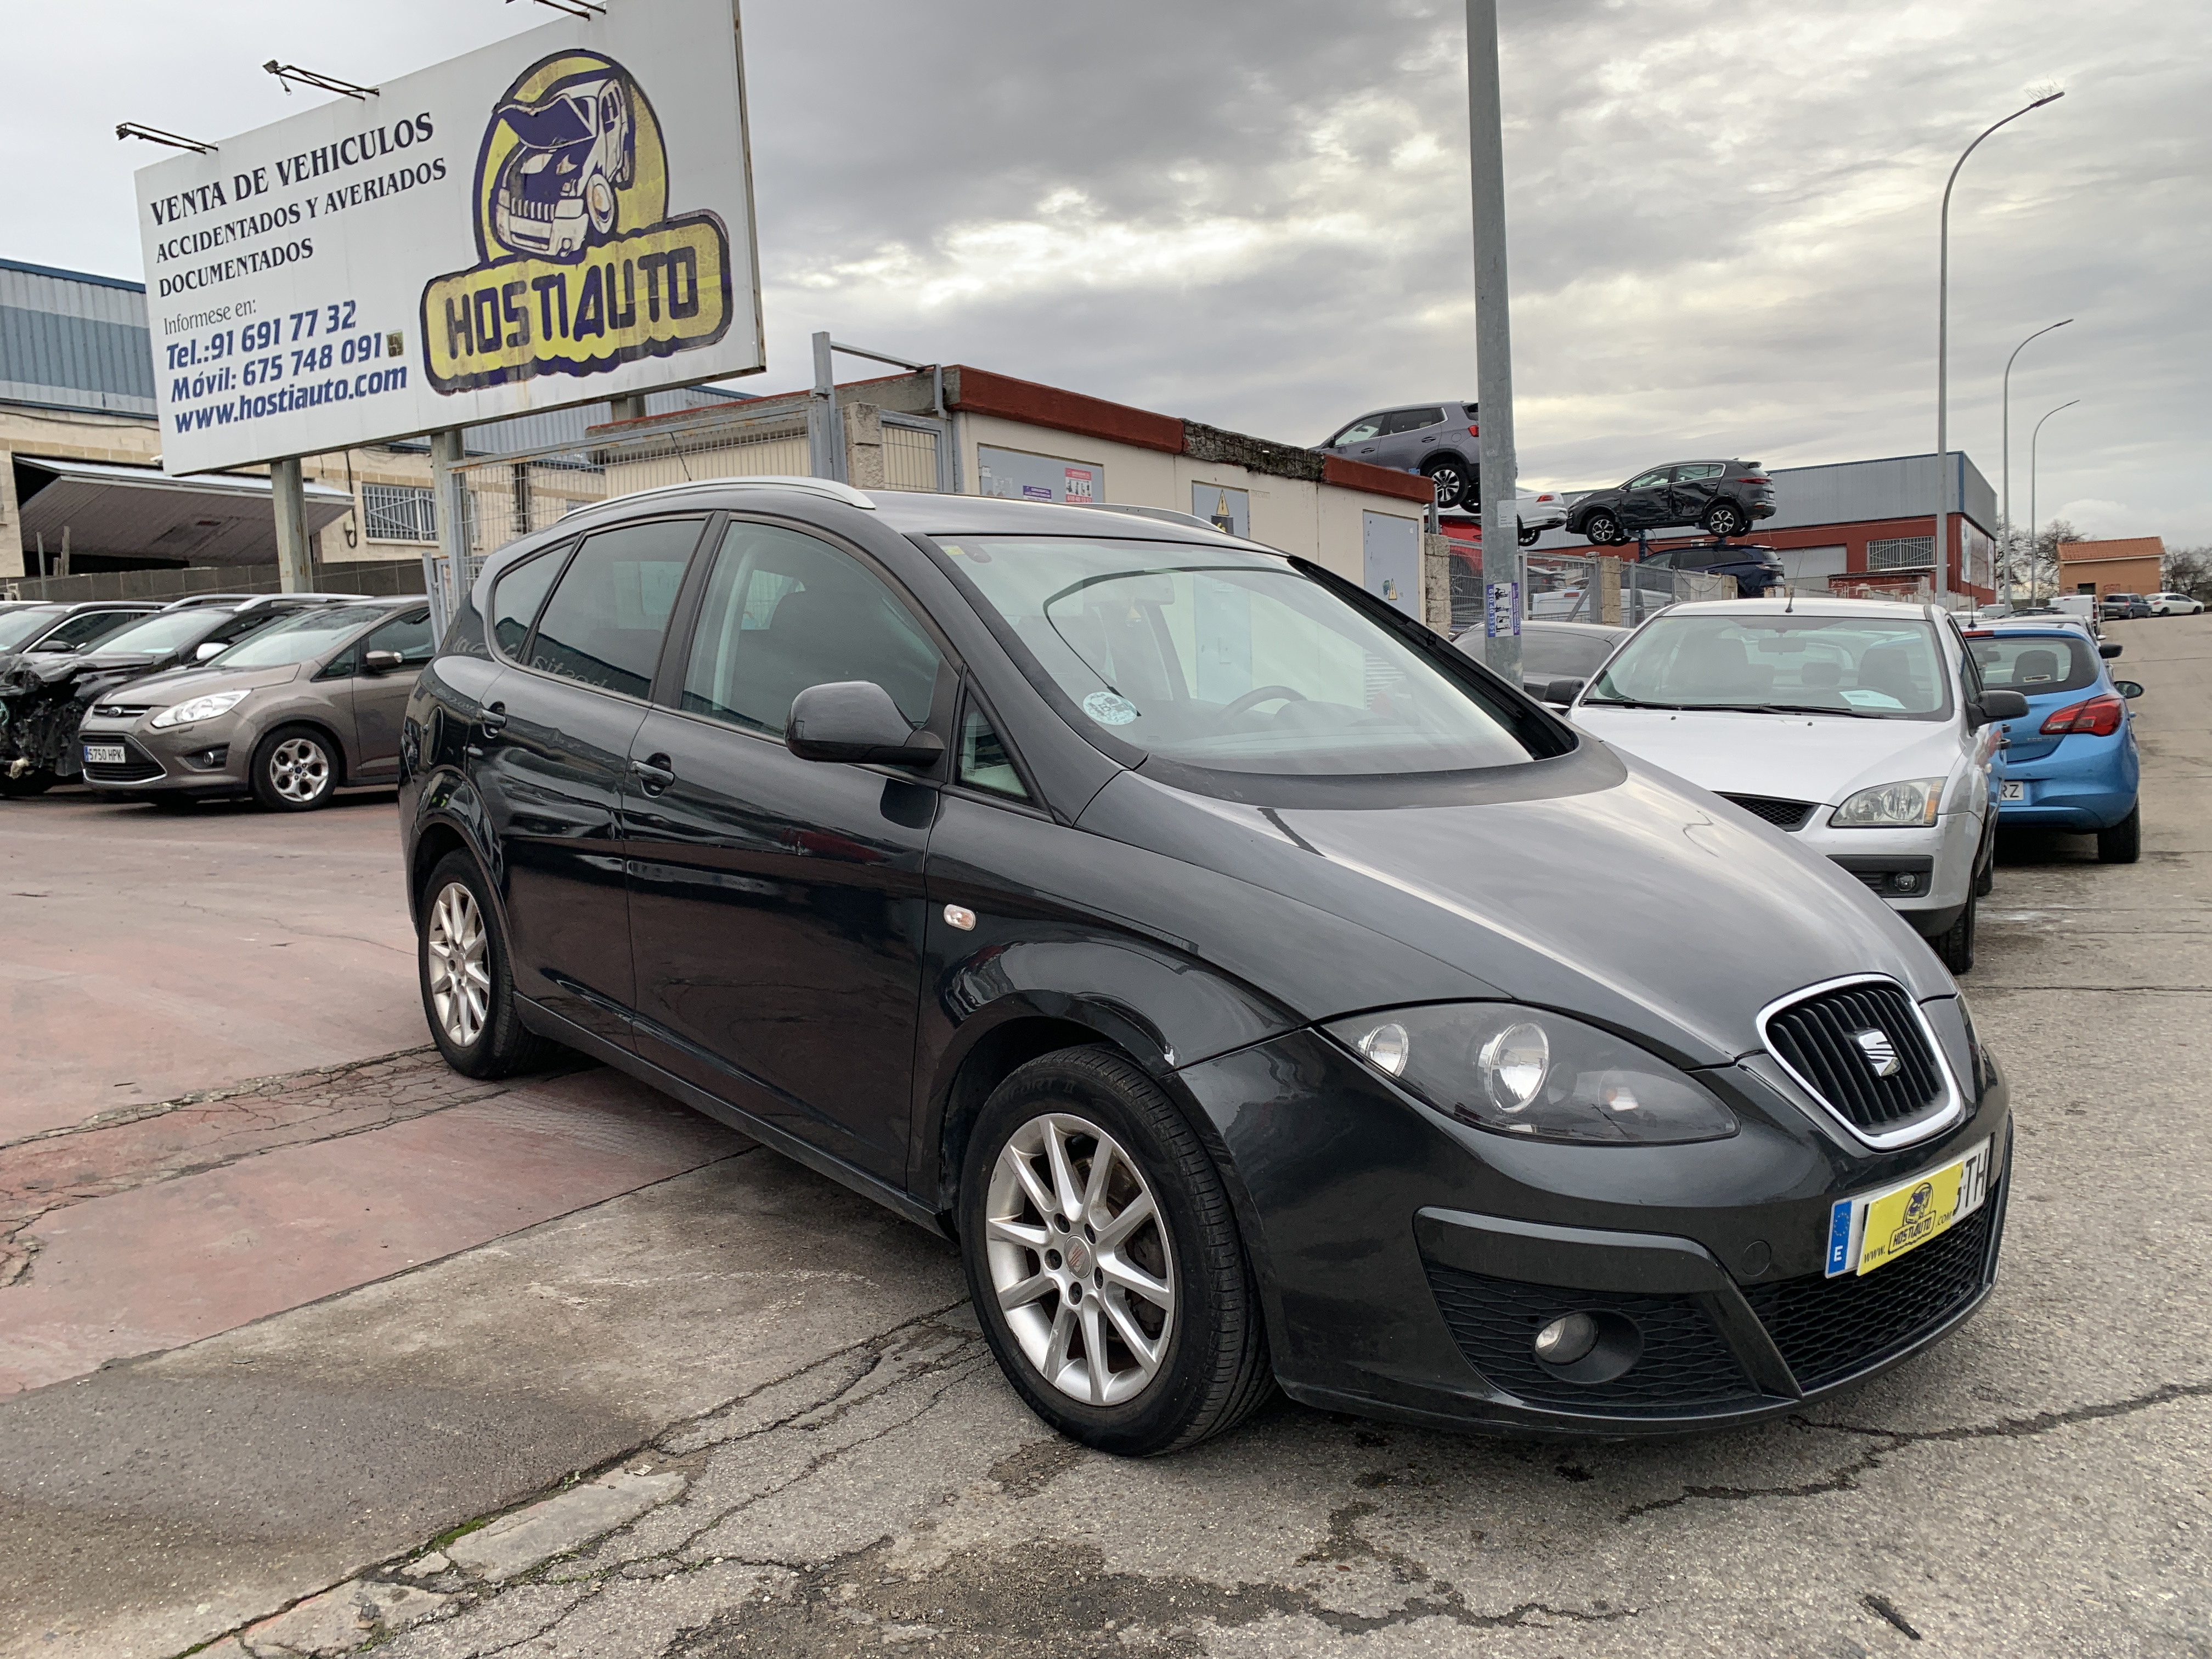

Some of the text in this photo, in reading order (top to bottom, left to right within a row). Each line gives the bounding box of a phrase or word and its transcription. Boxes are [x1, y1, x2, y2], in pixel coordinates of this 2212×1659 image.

[150, 112, 433, 225] VENTA DE VEHICULOS
[156, 157, 446, 263] ACCIDENTADOS Y AVERIADOS
[159, 238, 313, 297] DOCUMENTADOS
[164, 298, 257, 335] Informese en:
[445, 246, 699, 360] HOSTIAUTO
[166, 300, 356, 370] Tel.:91 691 77 32
[171, 332, 382, 403] Móvil: 675 748 091
[175, 366, 407, 434] www.hostiauto.com
[1489, 605, 1494, 614] 40
[1489, 616, 1494, 624] 13
[1833, 1245, 1843, 1262] E
[1893, 1217, 1932, 1246] HOSTIAUTO
